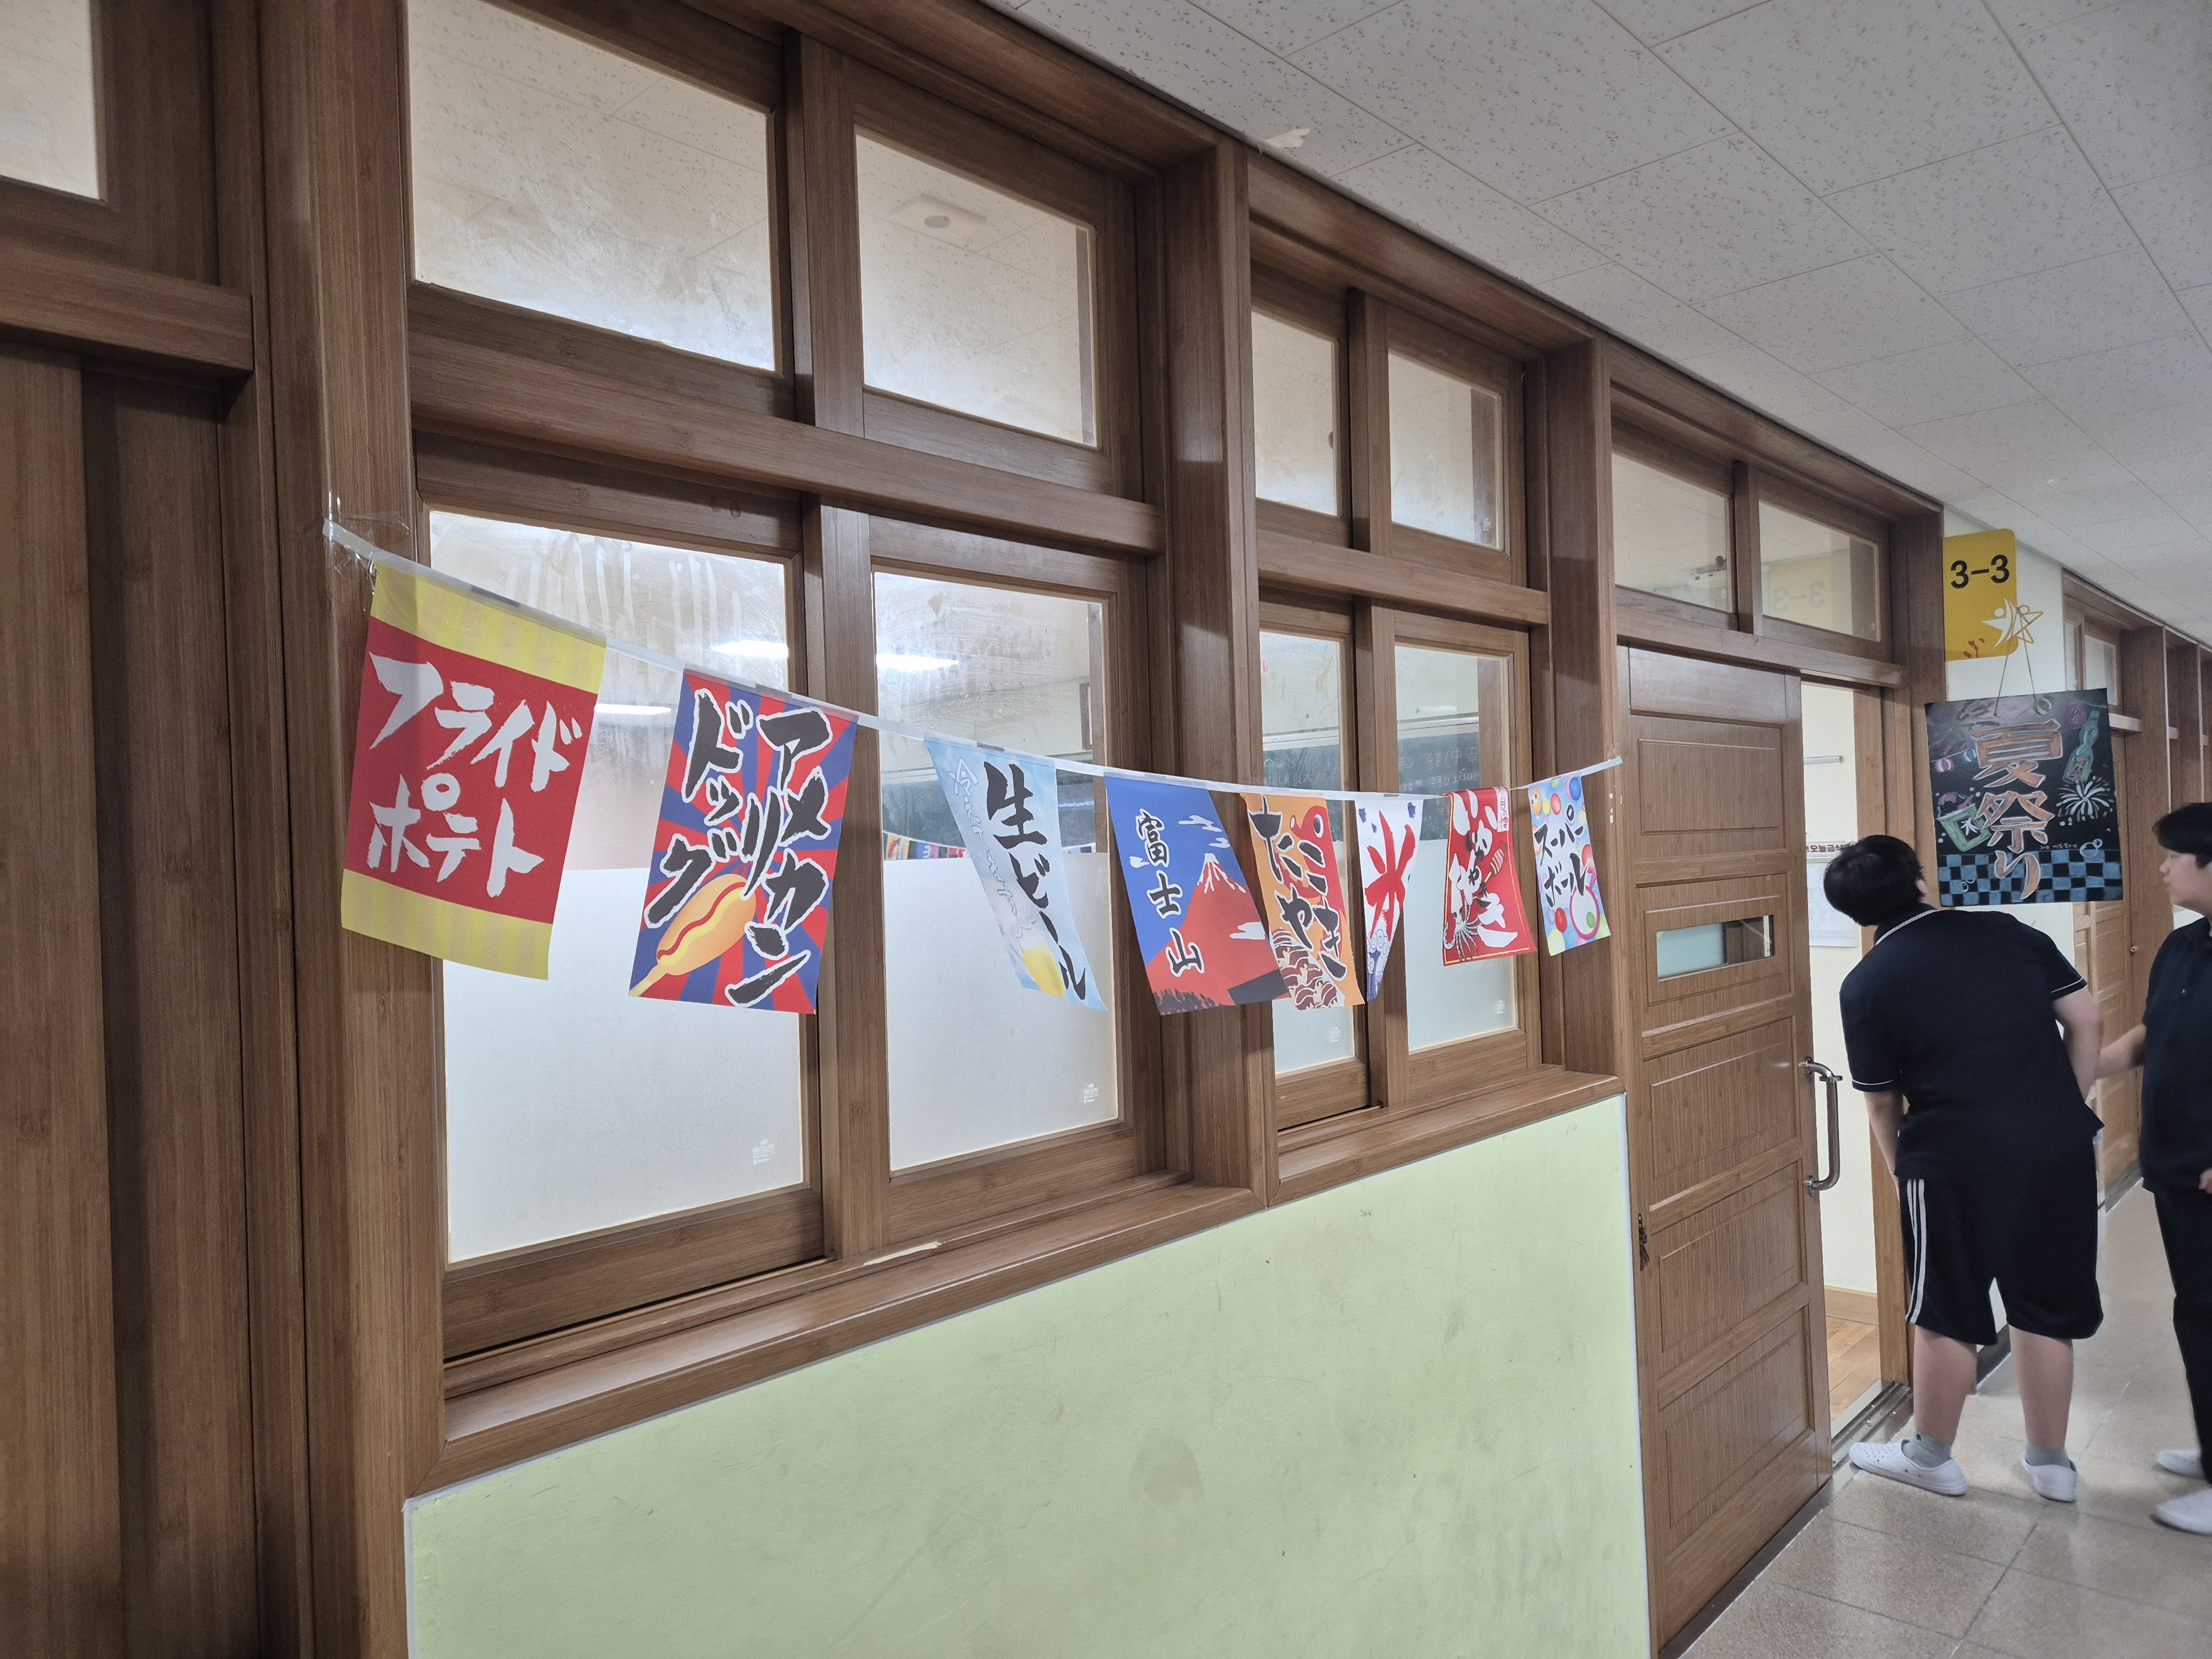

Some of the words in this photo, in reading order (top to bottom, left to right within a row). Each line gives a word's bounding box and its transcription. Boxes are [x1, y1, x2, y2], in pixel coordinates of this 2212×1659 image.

[1950, 554, 2010, 589] 3-3
[368, 651, 583, 792] フライド
[366, 773, 544, 898] ポテト
[643, 688, 753, 930] ドッグ
[726, 706, 832, 1008] アメリカン
[983, 761, 1087, 1000] 生ビール
[1533, 804, 1584, 866] スーパー
[1543, 853, 1590, 908] ボール
[1971, 718, 2063, 900] 夏祭り
[1136, 808, 1205, 978] 富士山
